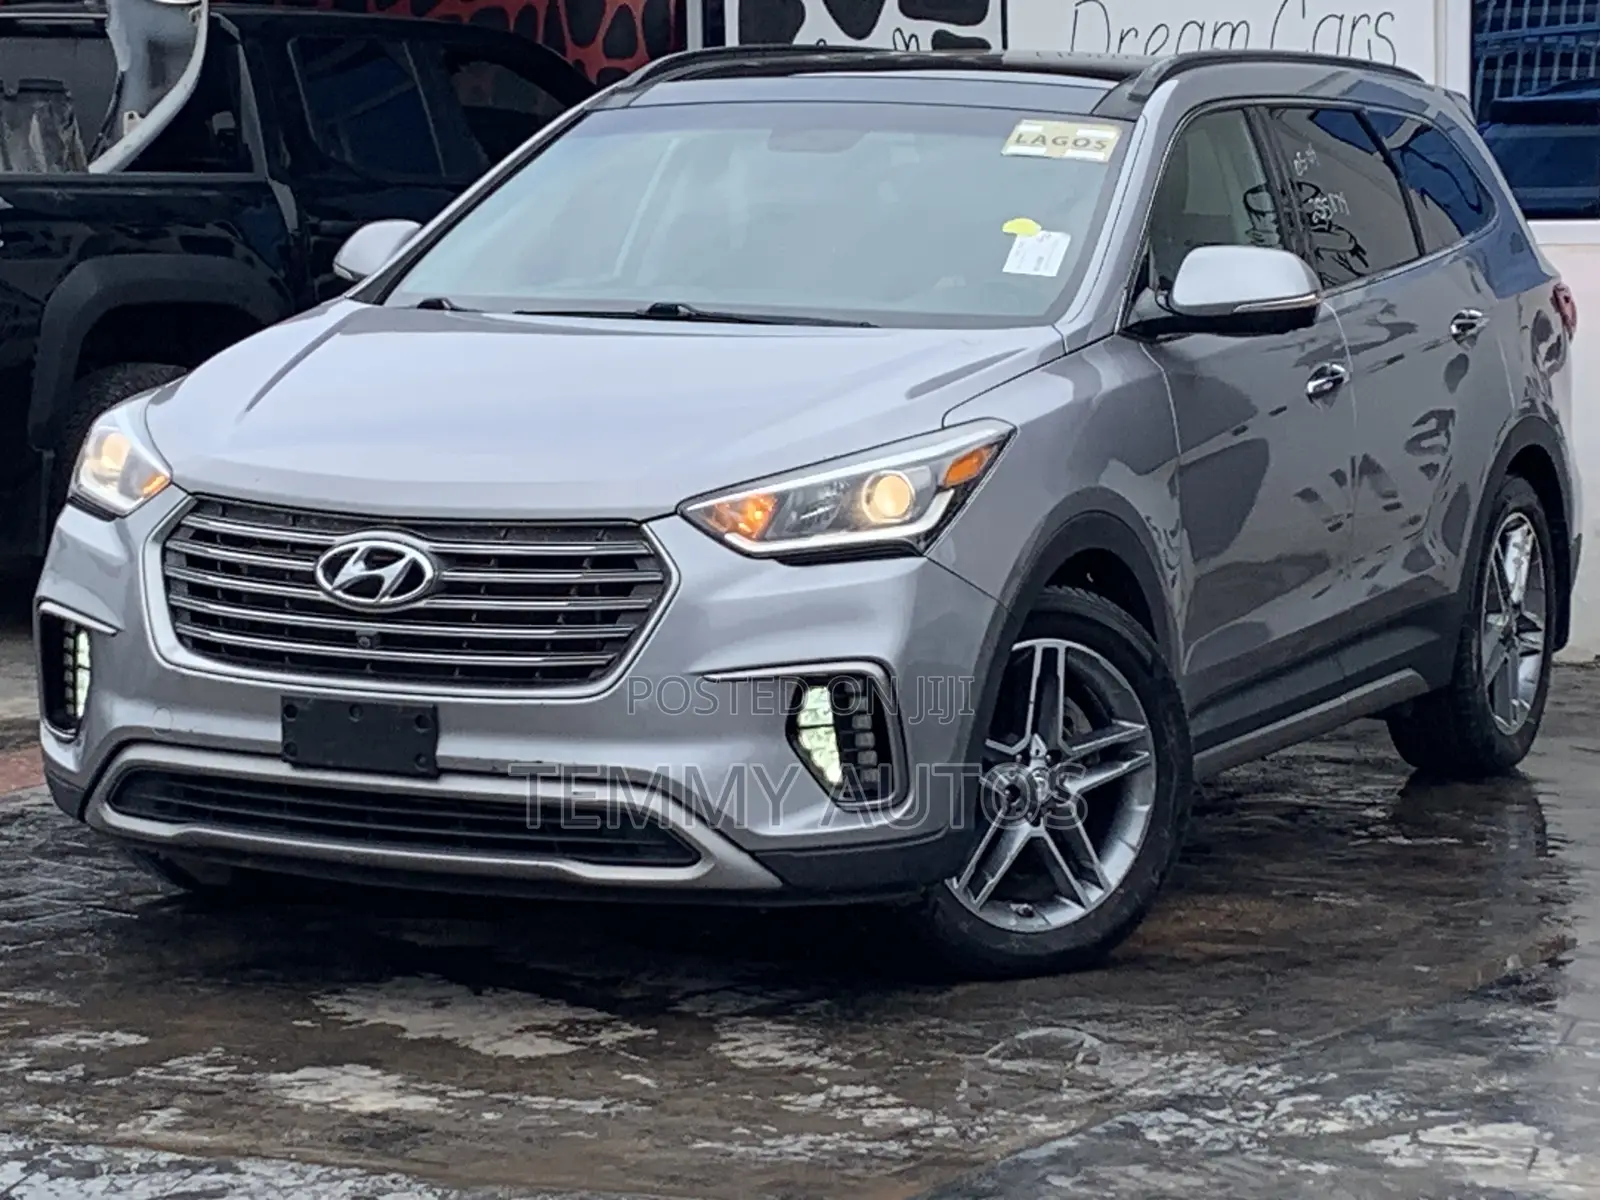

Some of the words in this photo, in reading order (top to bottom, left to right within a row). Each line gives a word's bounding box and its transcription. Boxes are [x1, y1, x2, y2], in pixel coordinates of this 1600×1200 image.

[1070, 0, 1250, 56] Dream
[1270, 0, 1396, 66] Cars
[1014, 132, 1108, 151] LAGOS
